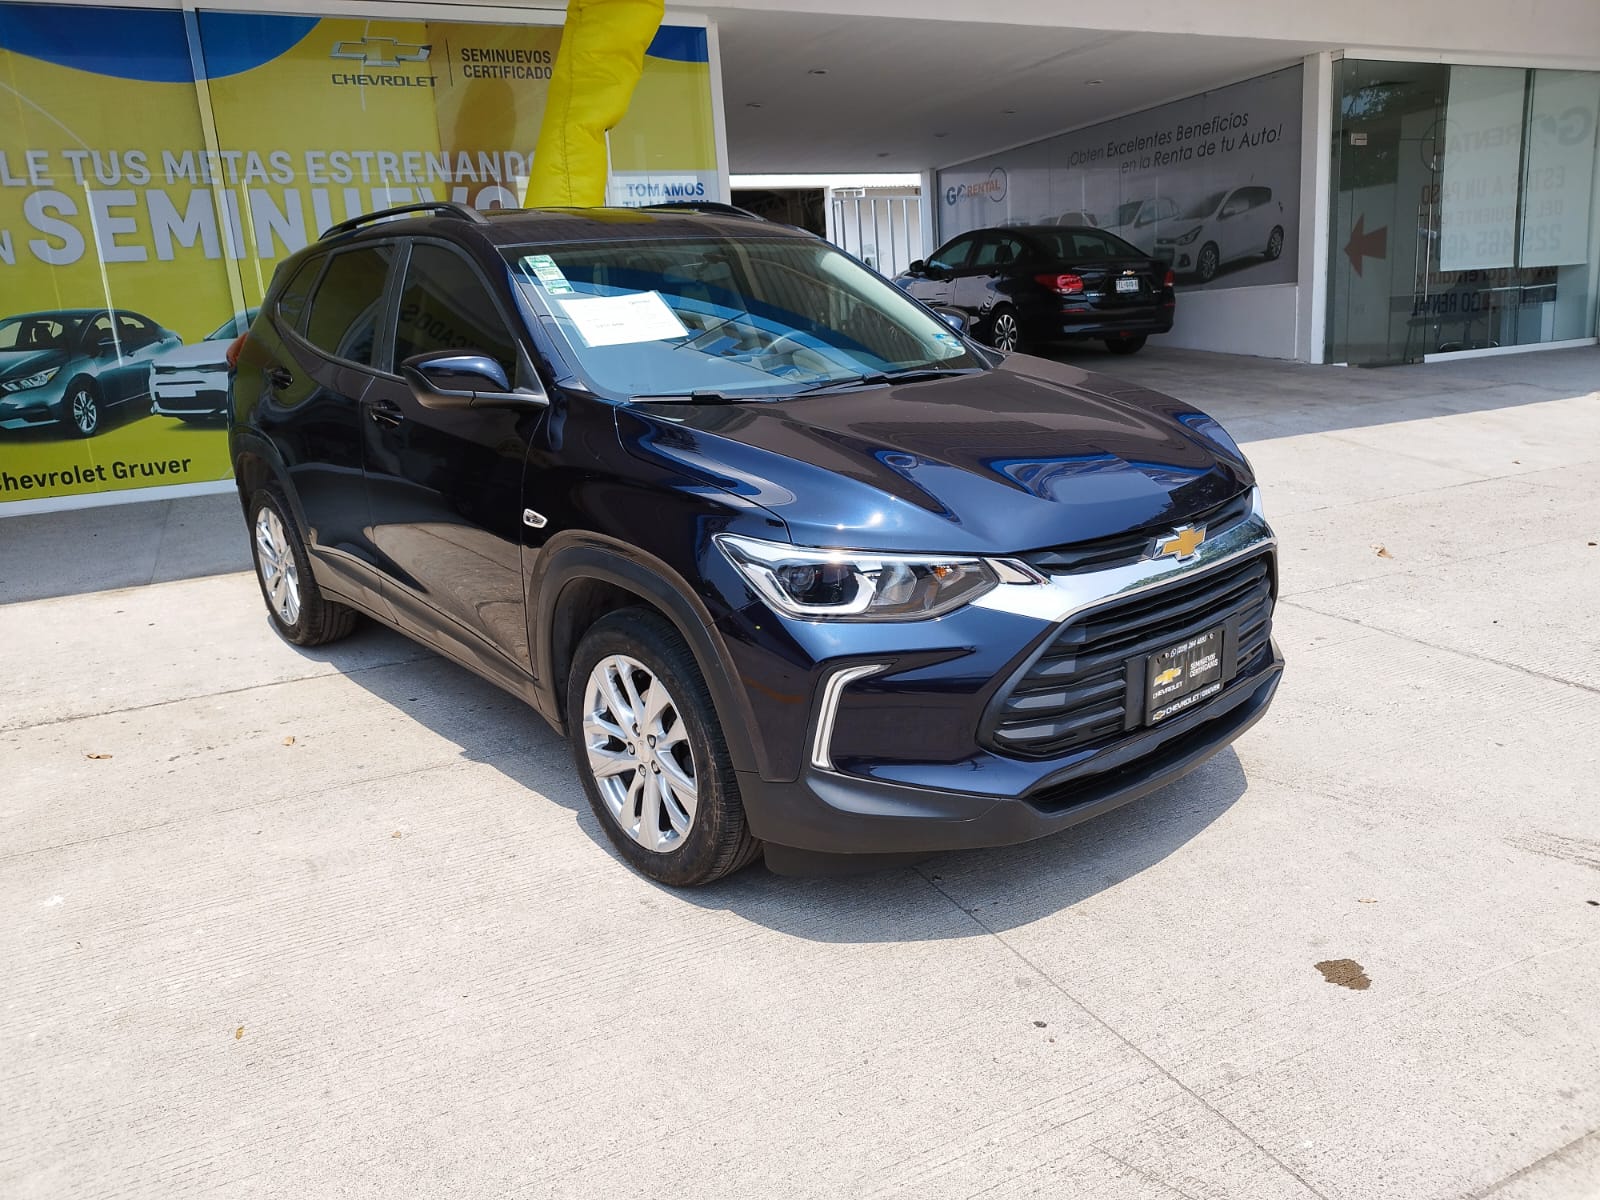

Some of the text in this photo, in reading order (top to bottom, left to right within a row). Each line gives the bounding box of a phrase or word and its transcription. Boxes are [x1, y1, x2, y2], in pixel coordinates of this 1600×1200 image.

[461, 48, 552, 63] SEMINUEVOS
[332, 73, 439, 88] CHEVROLET
[463, 64, 553, 80] CERTIFICADO
[1107, 130, 1173, 159] Excelentes
[1176, 112, 1249, 142] Beneficios
[1121, 124, 1283, 175] en la Renta de tu Auto!
[62, 150, 151, 186] TUS
[162, 150, 294, 185] METAS
[626, 183, 705, 197] TOMAMOS
[967, 179, 1001, 198] RENTAL
[0, 457, 192, 491] hevrolet Gruver
[1153, 680, 1183, 700] CHEVROLET
[1165, 692, 1200, 715] CHEVROLET
